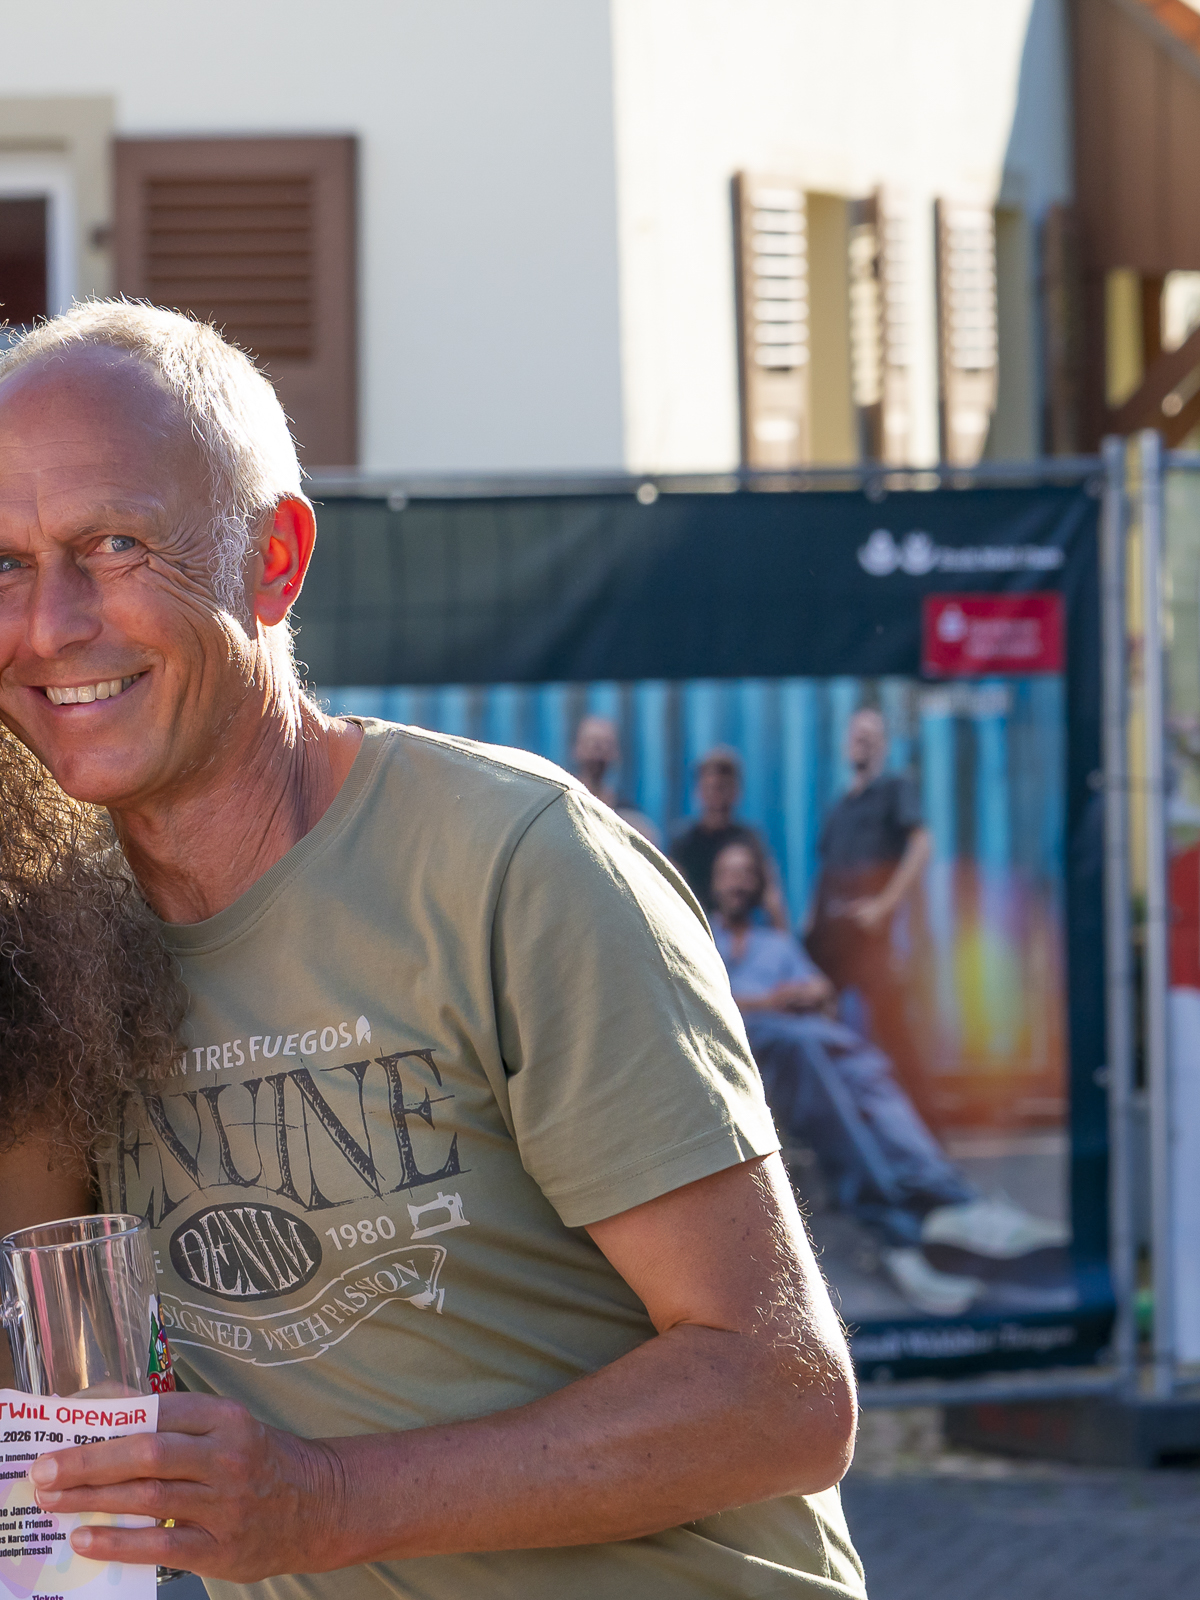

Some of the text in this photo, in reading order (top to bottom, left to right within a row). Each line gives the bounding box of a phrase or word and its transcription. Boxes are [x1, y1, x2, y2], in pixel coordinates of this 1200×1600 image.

[193, 1040, 245, 1072] TRES
[249, 1022, 353, 1062] FUEGOS
[104, 1049, 472, 1230] ENUINE
[325, 1215, 396, 1251] 1980
[177, 1207, 315, 1296] DENIM
[162, 1259, 420, 1352] SIGNED WITH PASSION
[34, 1431, 63, 1444] 17:00
[5, 1452, 39, 1463] Innenhof
[8, 1533, 39, 1543] Narcotik
[18, 1521, 23, 1529] &
[25, 1519, 53, 1529] Friends
